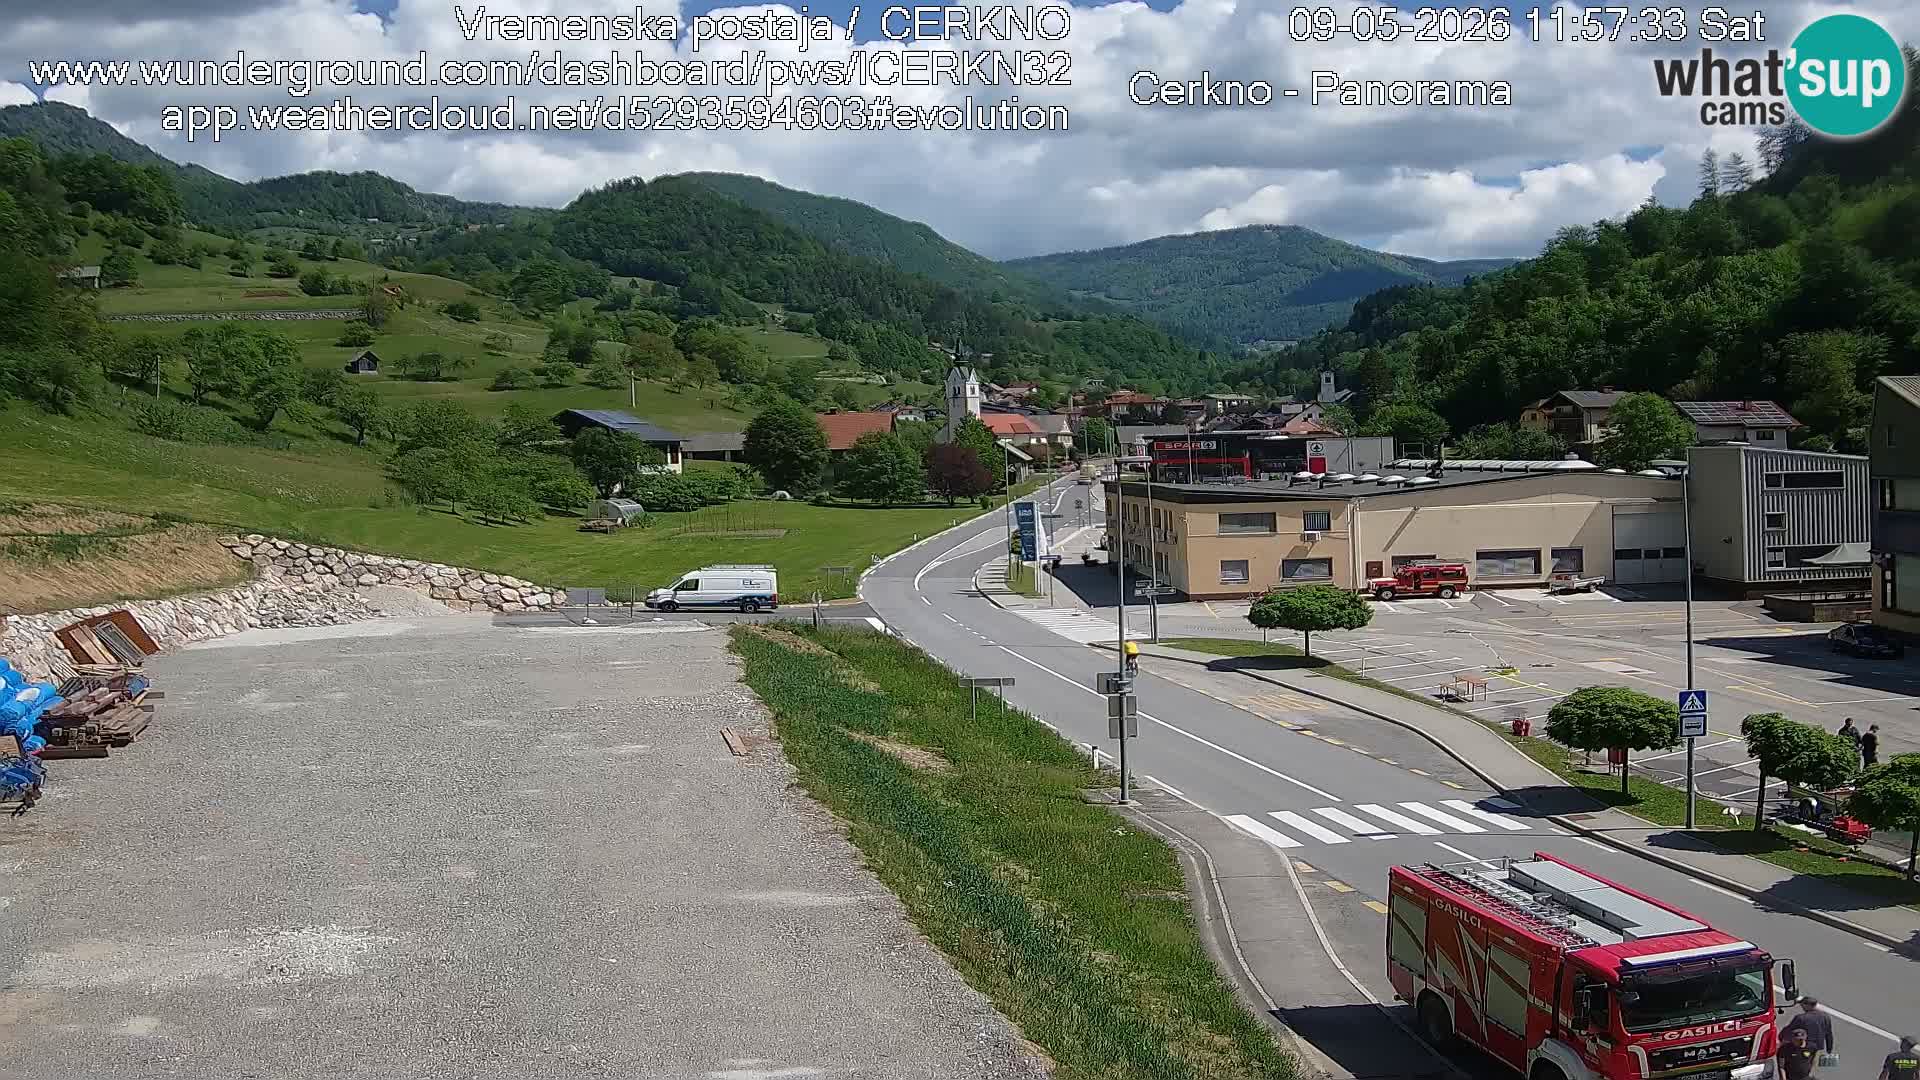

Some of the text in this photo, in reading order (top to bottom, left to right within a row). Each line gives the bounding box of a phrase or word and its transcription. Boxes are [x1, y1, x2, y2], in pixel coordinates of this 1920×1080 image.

[1165, 442, 1200, 450] SPAR
[1435, 898, 1481, 929] GASILCI
[1663, 1020, 1743, 1041] GASILCI
[1684, 1045, 1721, 1058] MAN
